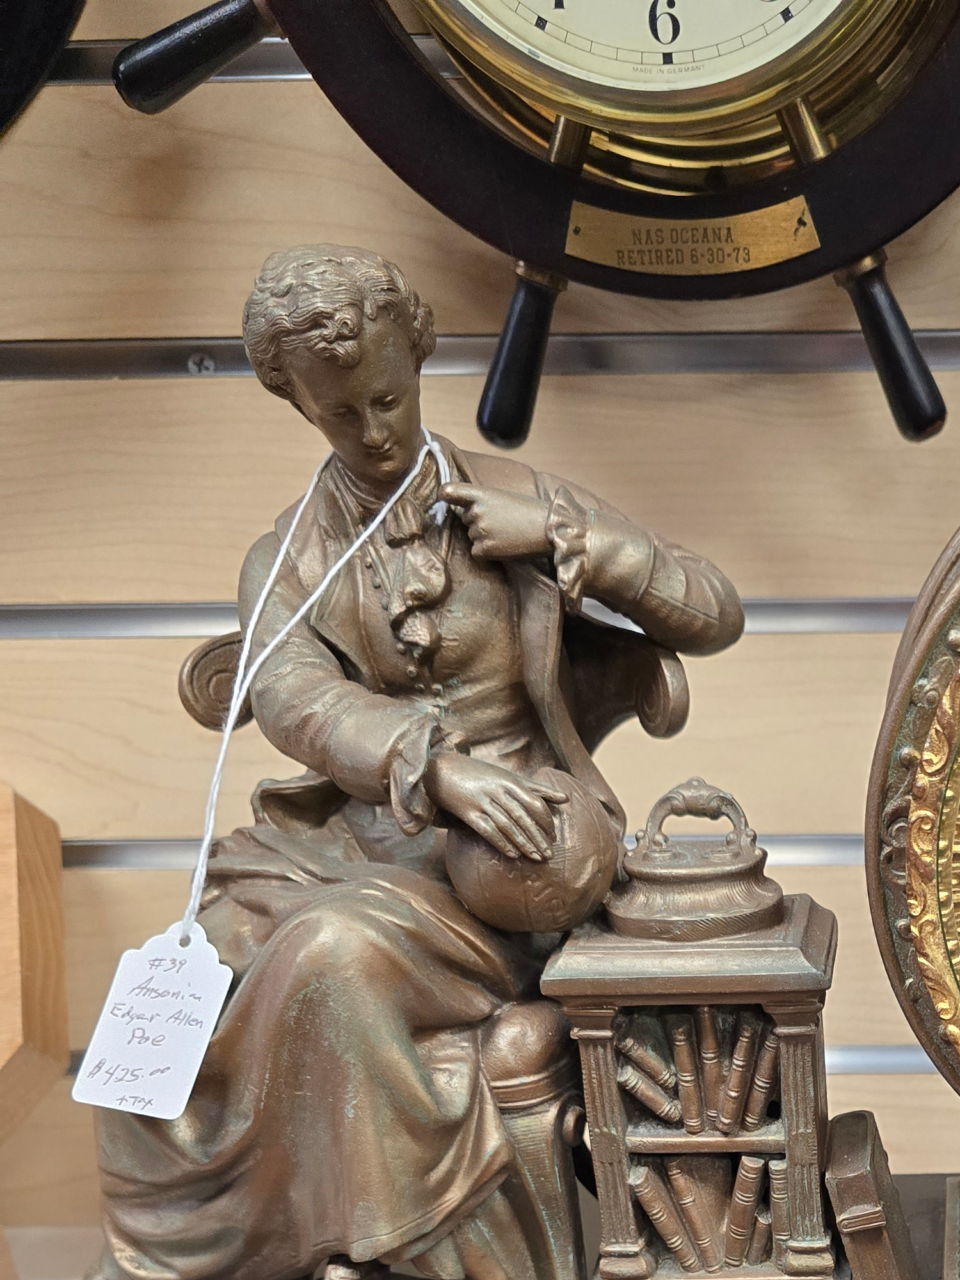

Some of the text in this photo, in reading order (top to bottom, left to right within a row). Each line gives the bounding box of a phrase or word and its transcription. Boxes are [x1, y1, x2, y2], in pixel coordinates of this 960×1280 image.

[648, 0, 681, 45] 6
[632, 66, 653, 75] MADE
[666, 64, 706, 75] GERMANY
[632, 226, 734, 245] NAS OCEANA
[616, 247, 751, 266] RETIRED 6-30-73
[109, 1002, 161, 1026] Edgar
[127, 1027, 166, 1047] Poe
